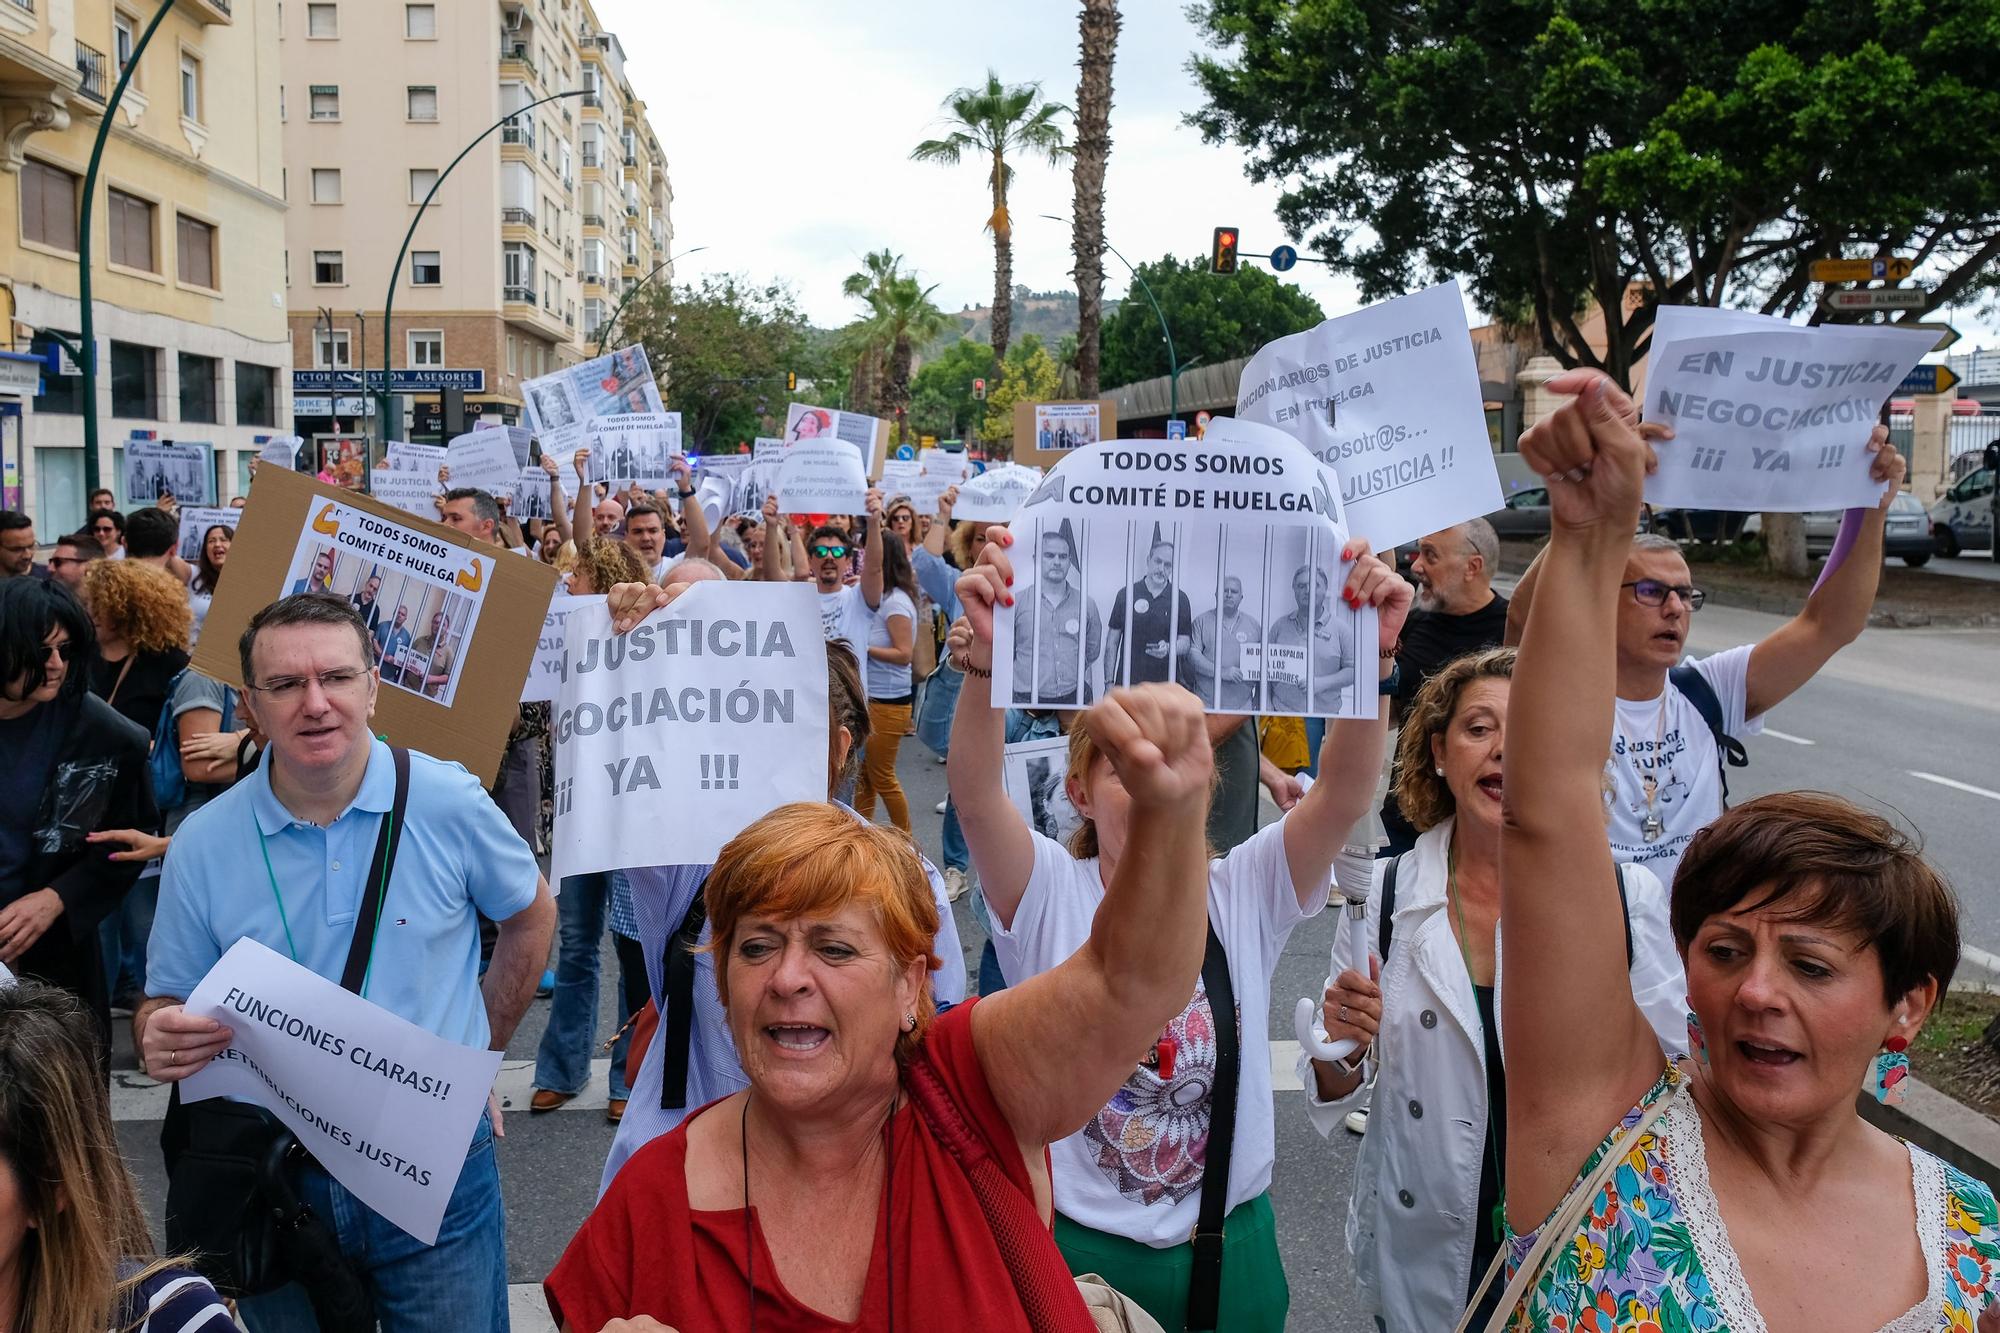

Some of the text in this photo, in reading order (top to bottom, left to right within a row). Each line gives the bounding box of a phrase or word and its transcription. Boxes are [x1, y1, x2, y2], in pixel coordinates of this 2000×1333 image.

[1874, 261, 1884, 276] P
[415, 372, 474, 382] ASESORES
[1237, 327, 1442, 416] UNCIONARI@S DE JUSTICIA
[1678, 350, 1897, 389] EN JUSTICIA
[1276, 382, 1375, 424] EN HUELGA
[1658, 390, 1873, 432] NEGOCIACIÓN
[1100, 452, 1285, 476] TODOS SOMOS
[1342, 446, 1454, 501] JUSTICIA !!
[1691, 444, 1846, 472] ¡¡¡ YA !!!
[389, 478, 432, 486] JUSTICIA
[816, 488, 855, 496] JUSTICIA
[1069, 483, 1314, 513] COMITÉ DE HUELGA
[397, 501, 407, 510] YA
[359, 516, 448, 559] TODOS SOMOS
[338, 532, 456, 584] COMITÉ DE HUELGA
[576, 619, 796, 674] JUSTICIA
[1280, 649, 1304, 660] ESPALDA
[1248, 670, 1299, 684] TRAAJADORES
[1272, 660, 1285, 670] LOS
[604, 754, 662, 796] YA
[700, 754, 740, 790] !!!
[222, 987, 452, 1101] FUNCIONES CLARAS!!
[212, 1048, 432, 1187] RETRIBUCIONES JUSTAS
